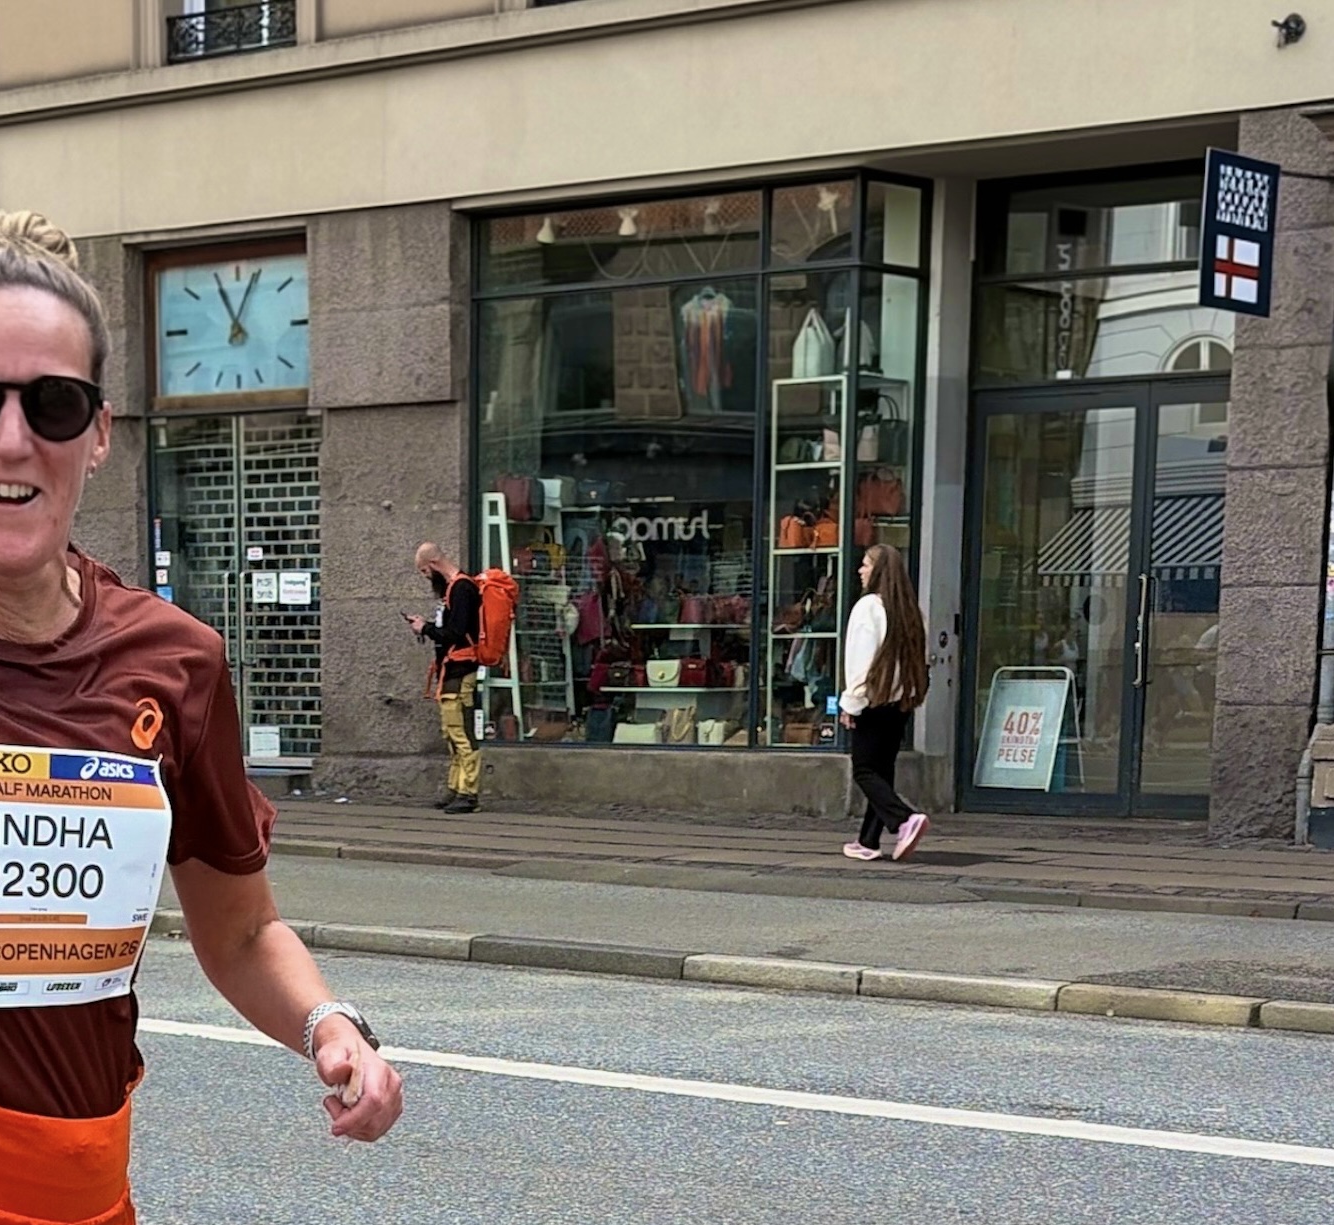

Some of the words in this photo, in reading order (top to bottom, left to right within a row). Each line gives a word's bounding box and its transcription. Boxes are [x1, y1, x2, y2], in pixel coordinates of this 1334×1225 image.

[1003, 711, 1043, 735] 40%
[998, 748, 1037, 763] PELSE
[26, 783, 112, 800] MARATHON
[119, 940, 139, 958] 26
